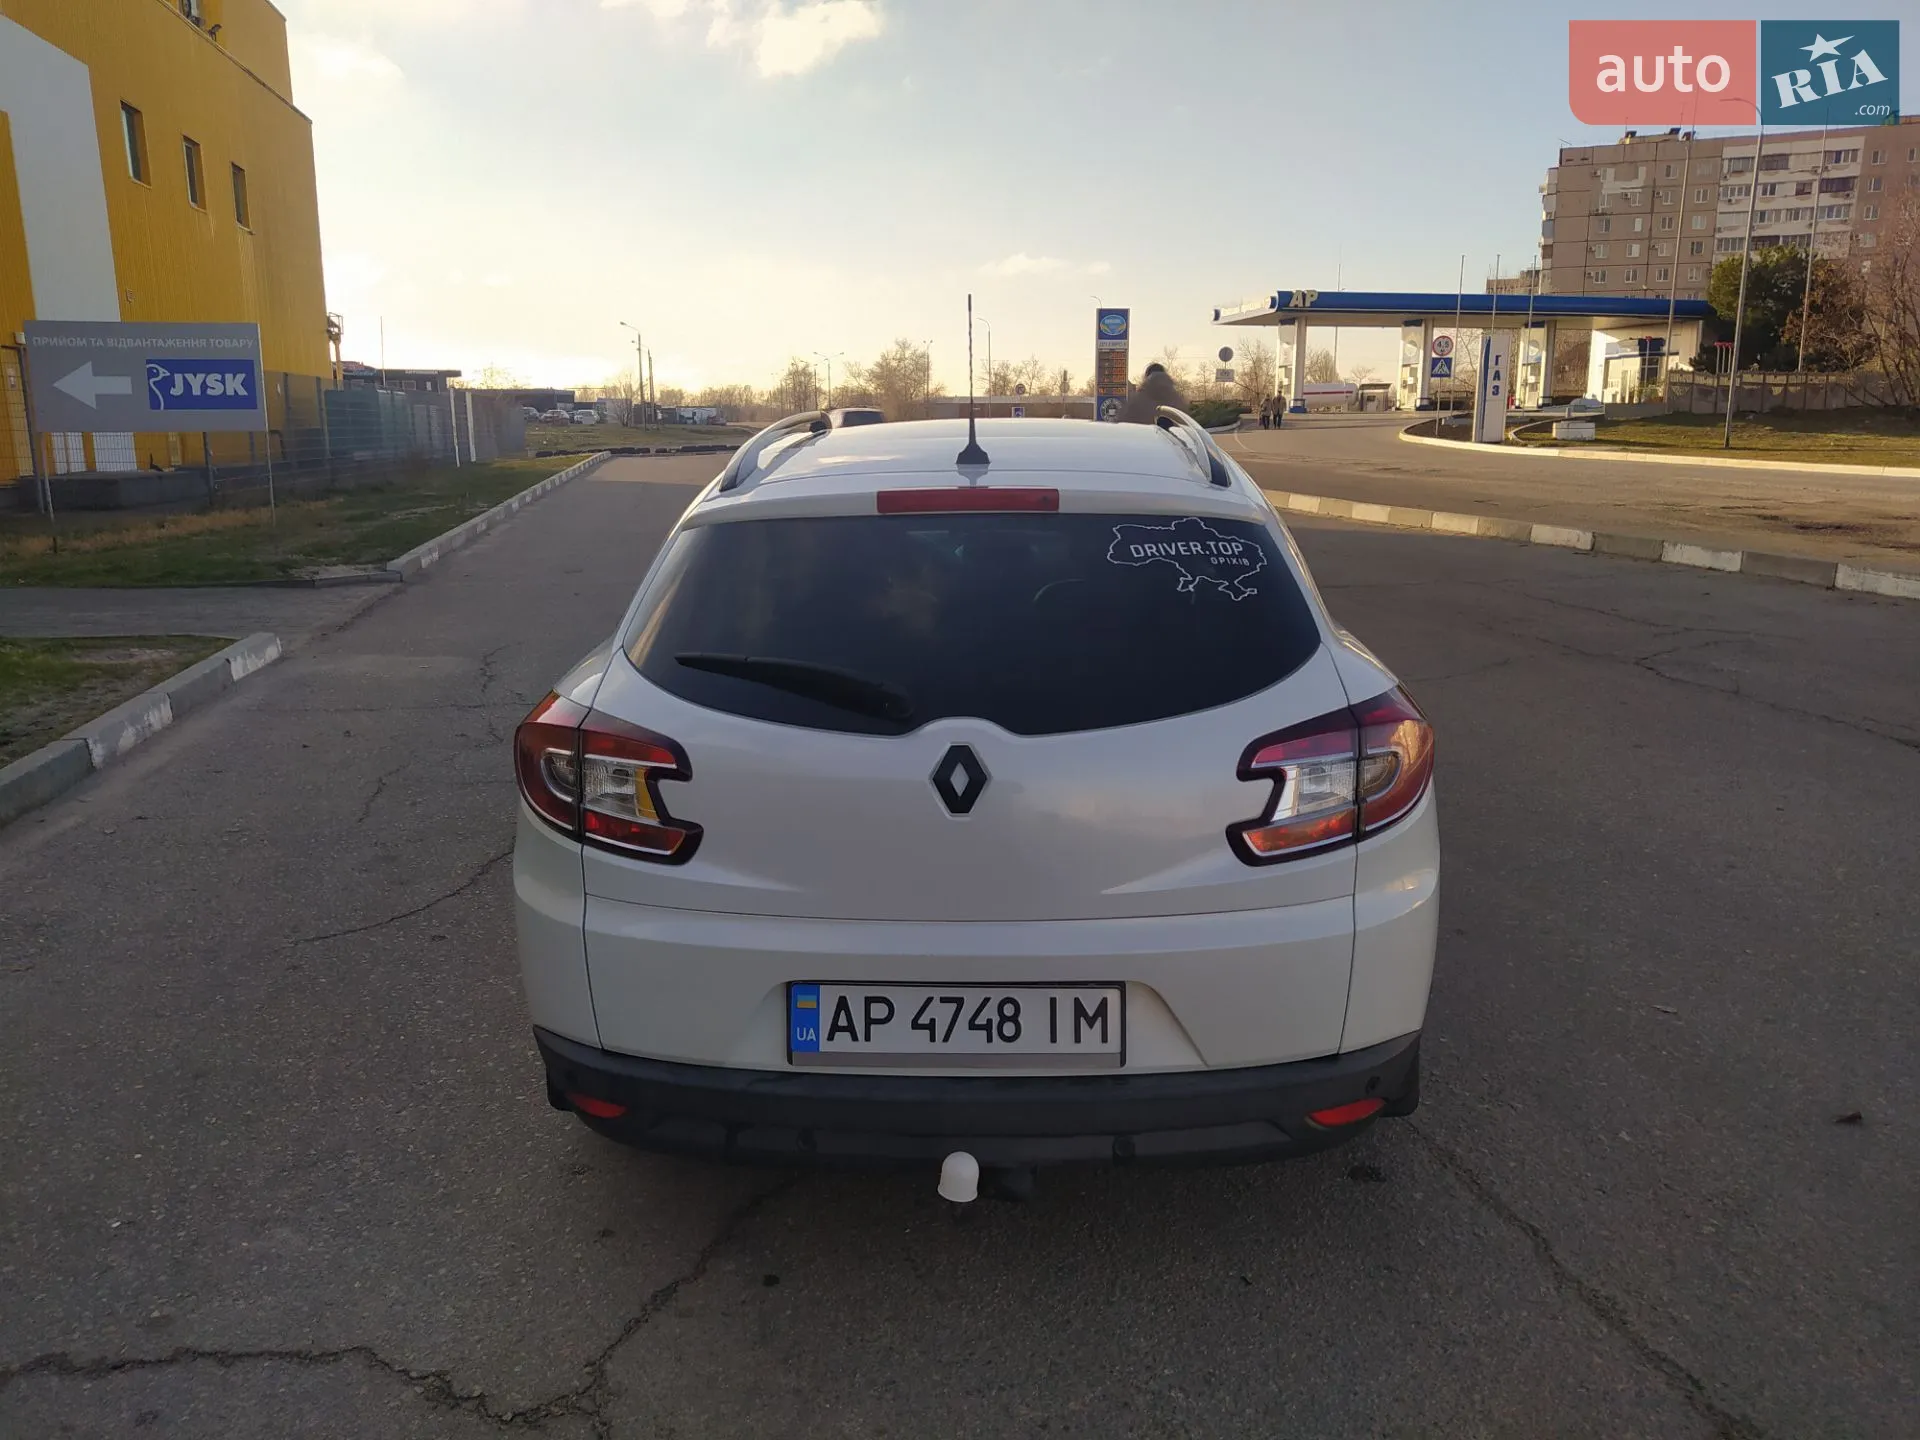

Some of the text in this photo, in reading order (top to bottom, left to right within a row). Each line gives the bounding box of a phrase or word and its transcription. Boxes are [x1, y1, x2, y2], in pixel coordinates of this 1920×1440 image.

[32, 336, 254, 350] ПРИЙОМ ТА ВІДВАНТАЖЕННЯ ТОВАРУ
[169, 372, 248, 397] JYSK
[1129, 541, 1243, 557] DRIVER.TOP
[826, 995, 1109, 1044] AP 4748 IM
[796, 1027, 817, 1042] UA
